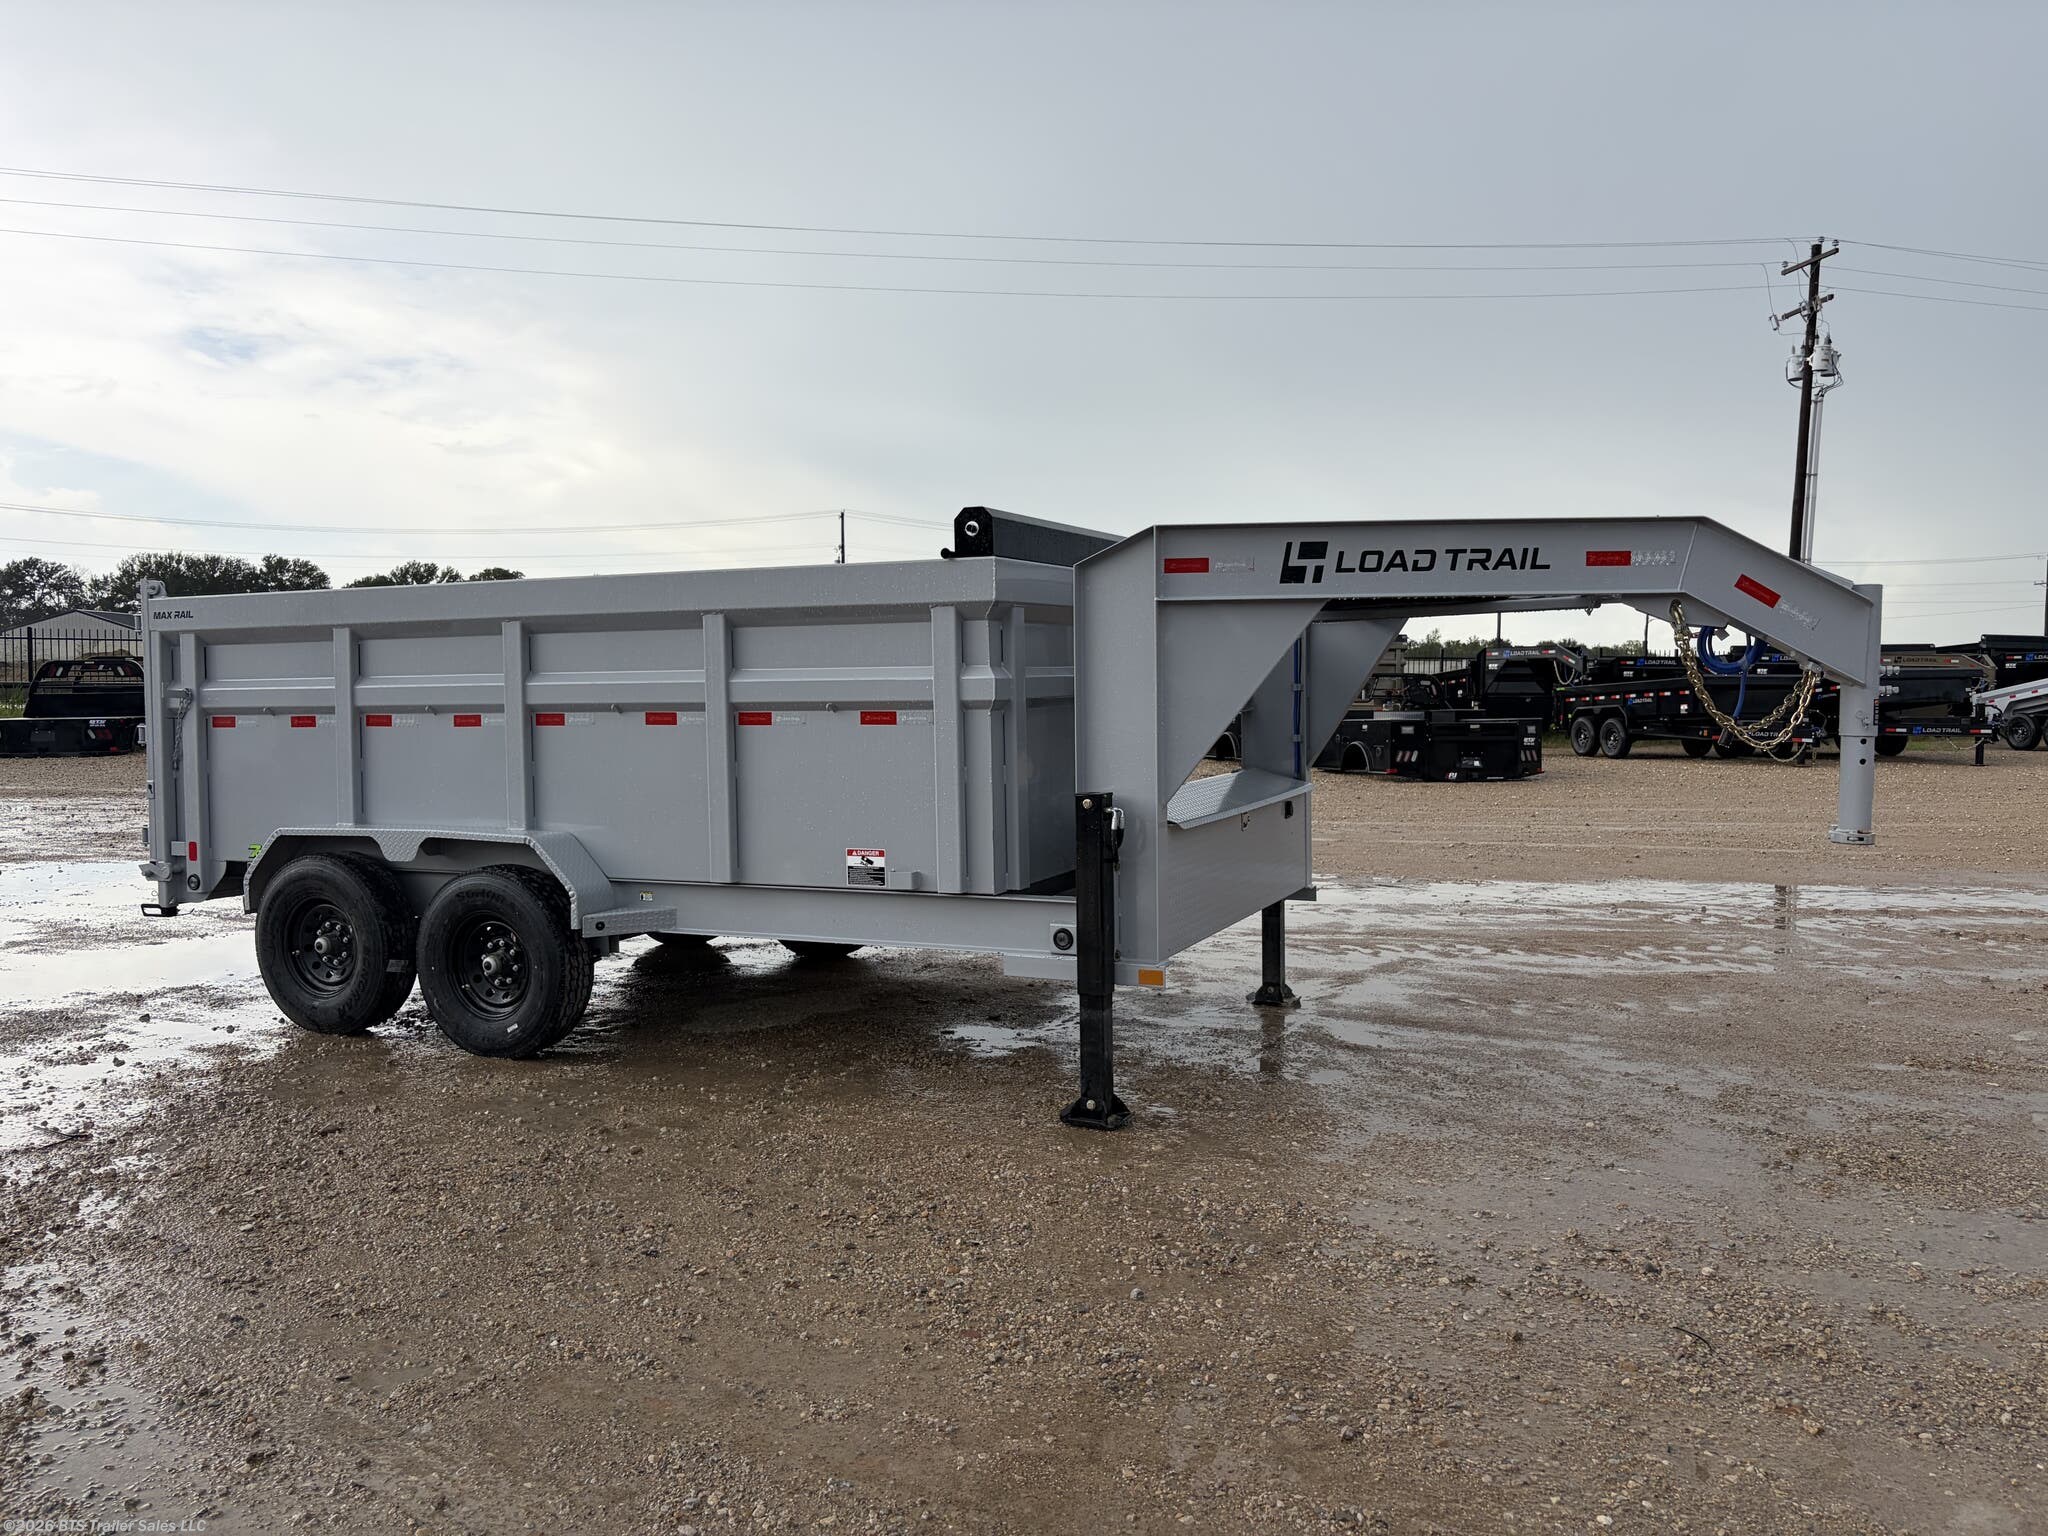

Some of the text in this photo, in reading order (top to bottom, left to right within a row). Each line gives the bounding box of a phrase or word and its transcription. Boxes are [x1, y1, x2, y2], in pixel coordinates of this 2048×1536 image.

[1335, 547, 1551, 573] LOAD TRAIL
[153, 610, 194, 620] MAX RAIL
